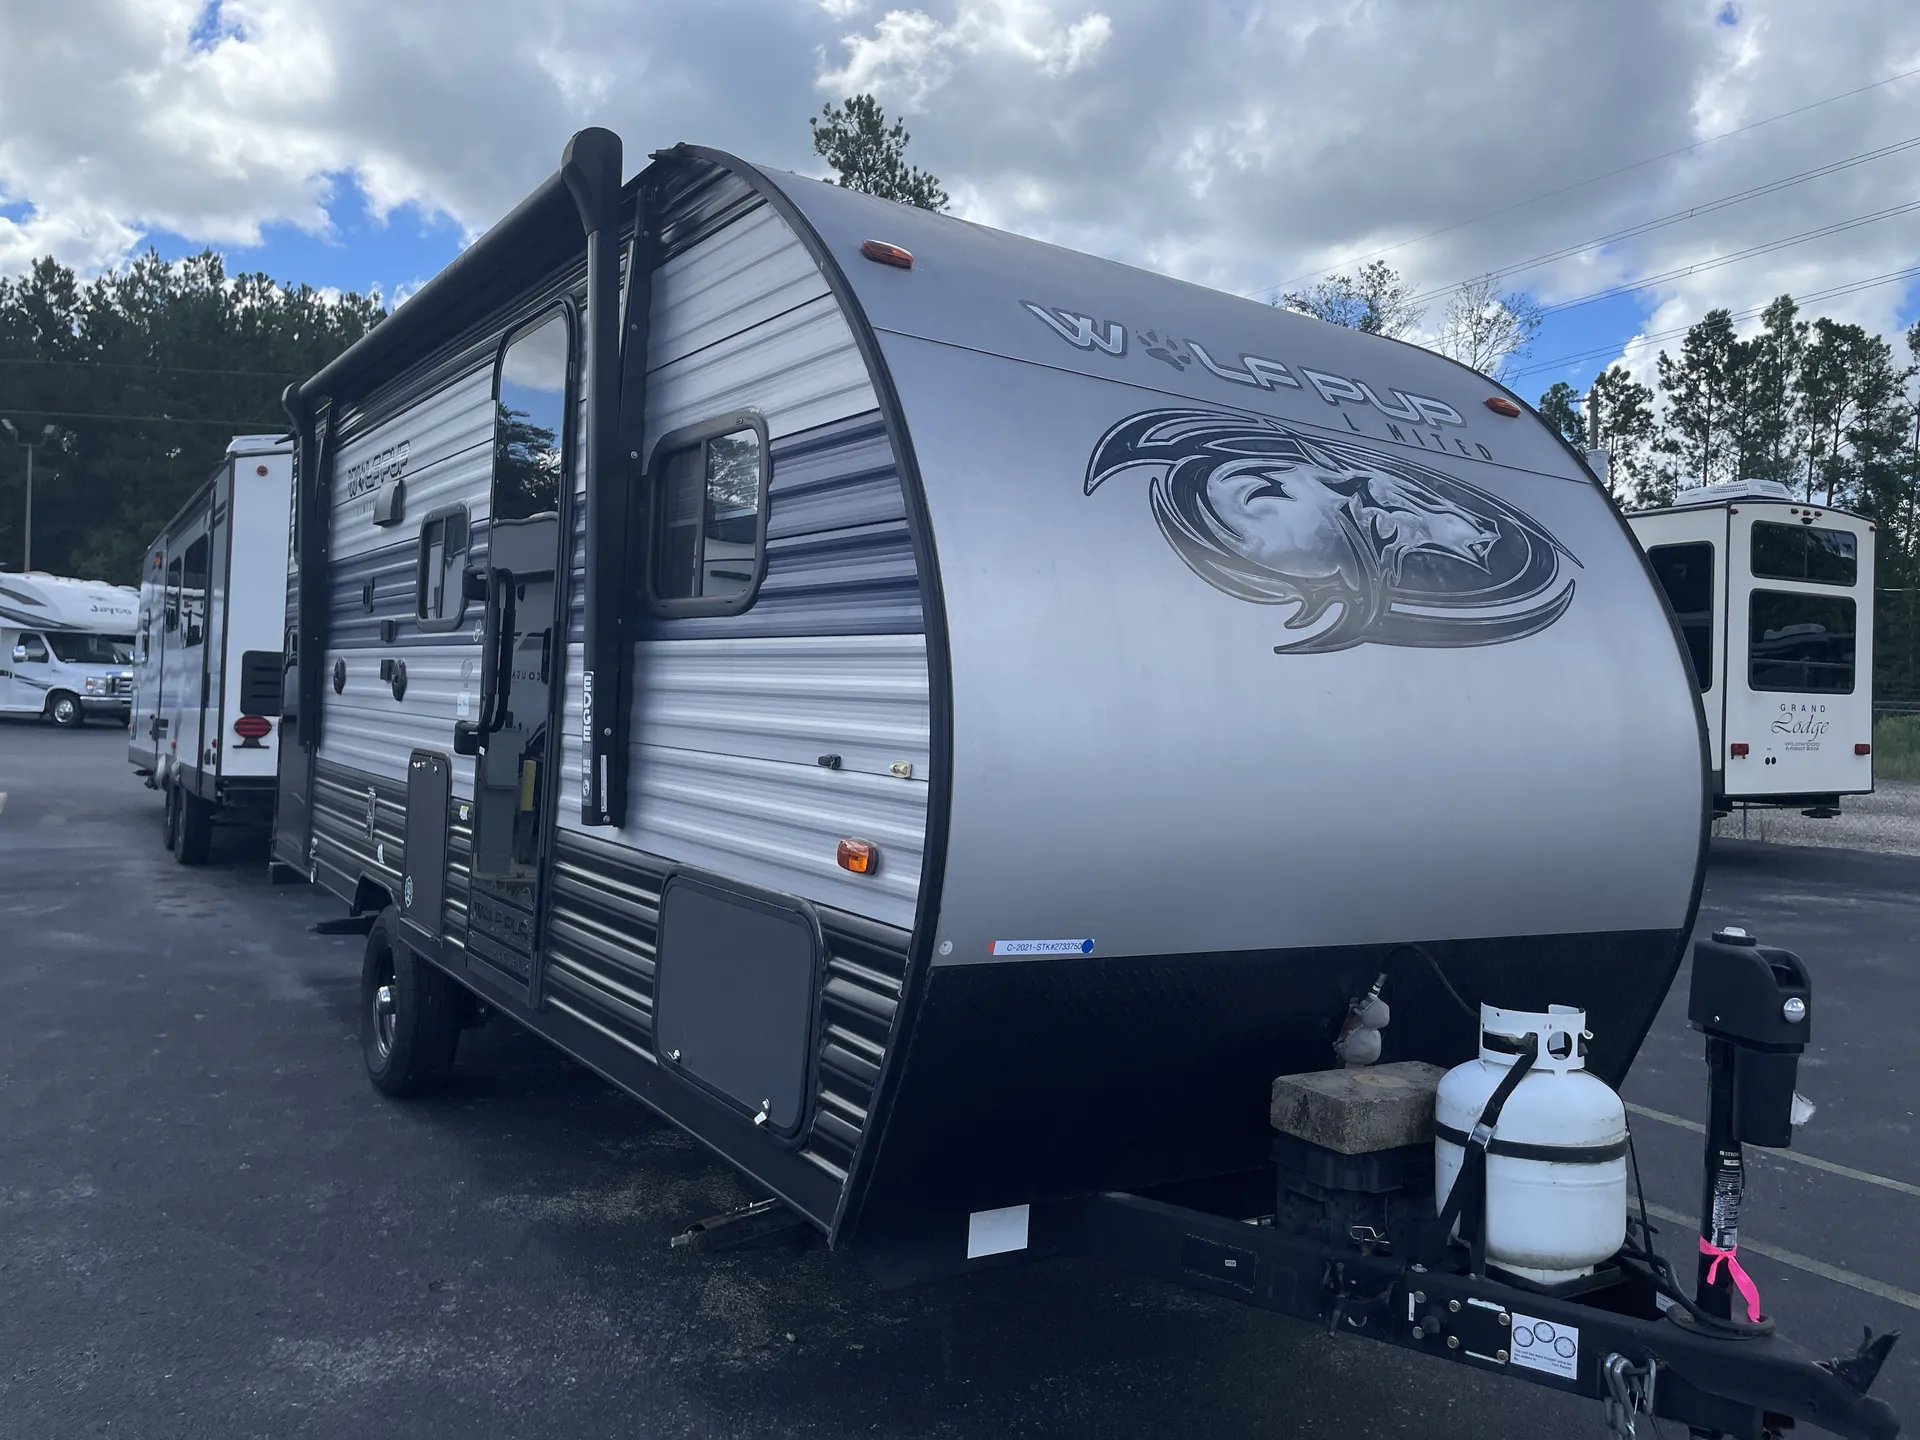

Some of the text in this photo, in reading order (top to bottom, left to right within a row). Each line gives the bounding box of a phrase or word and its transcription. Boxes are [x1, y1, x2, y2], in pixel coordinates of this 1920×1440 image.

[1019, 299, 1304, 392] WLF
[1342, 412, 1494, 461] LMITED
[583, 675, 592, 742] EDGE
[1771, 712, 1830, 742] Lodge
[1780, 703, 1826, 713] GRAND
